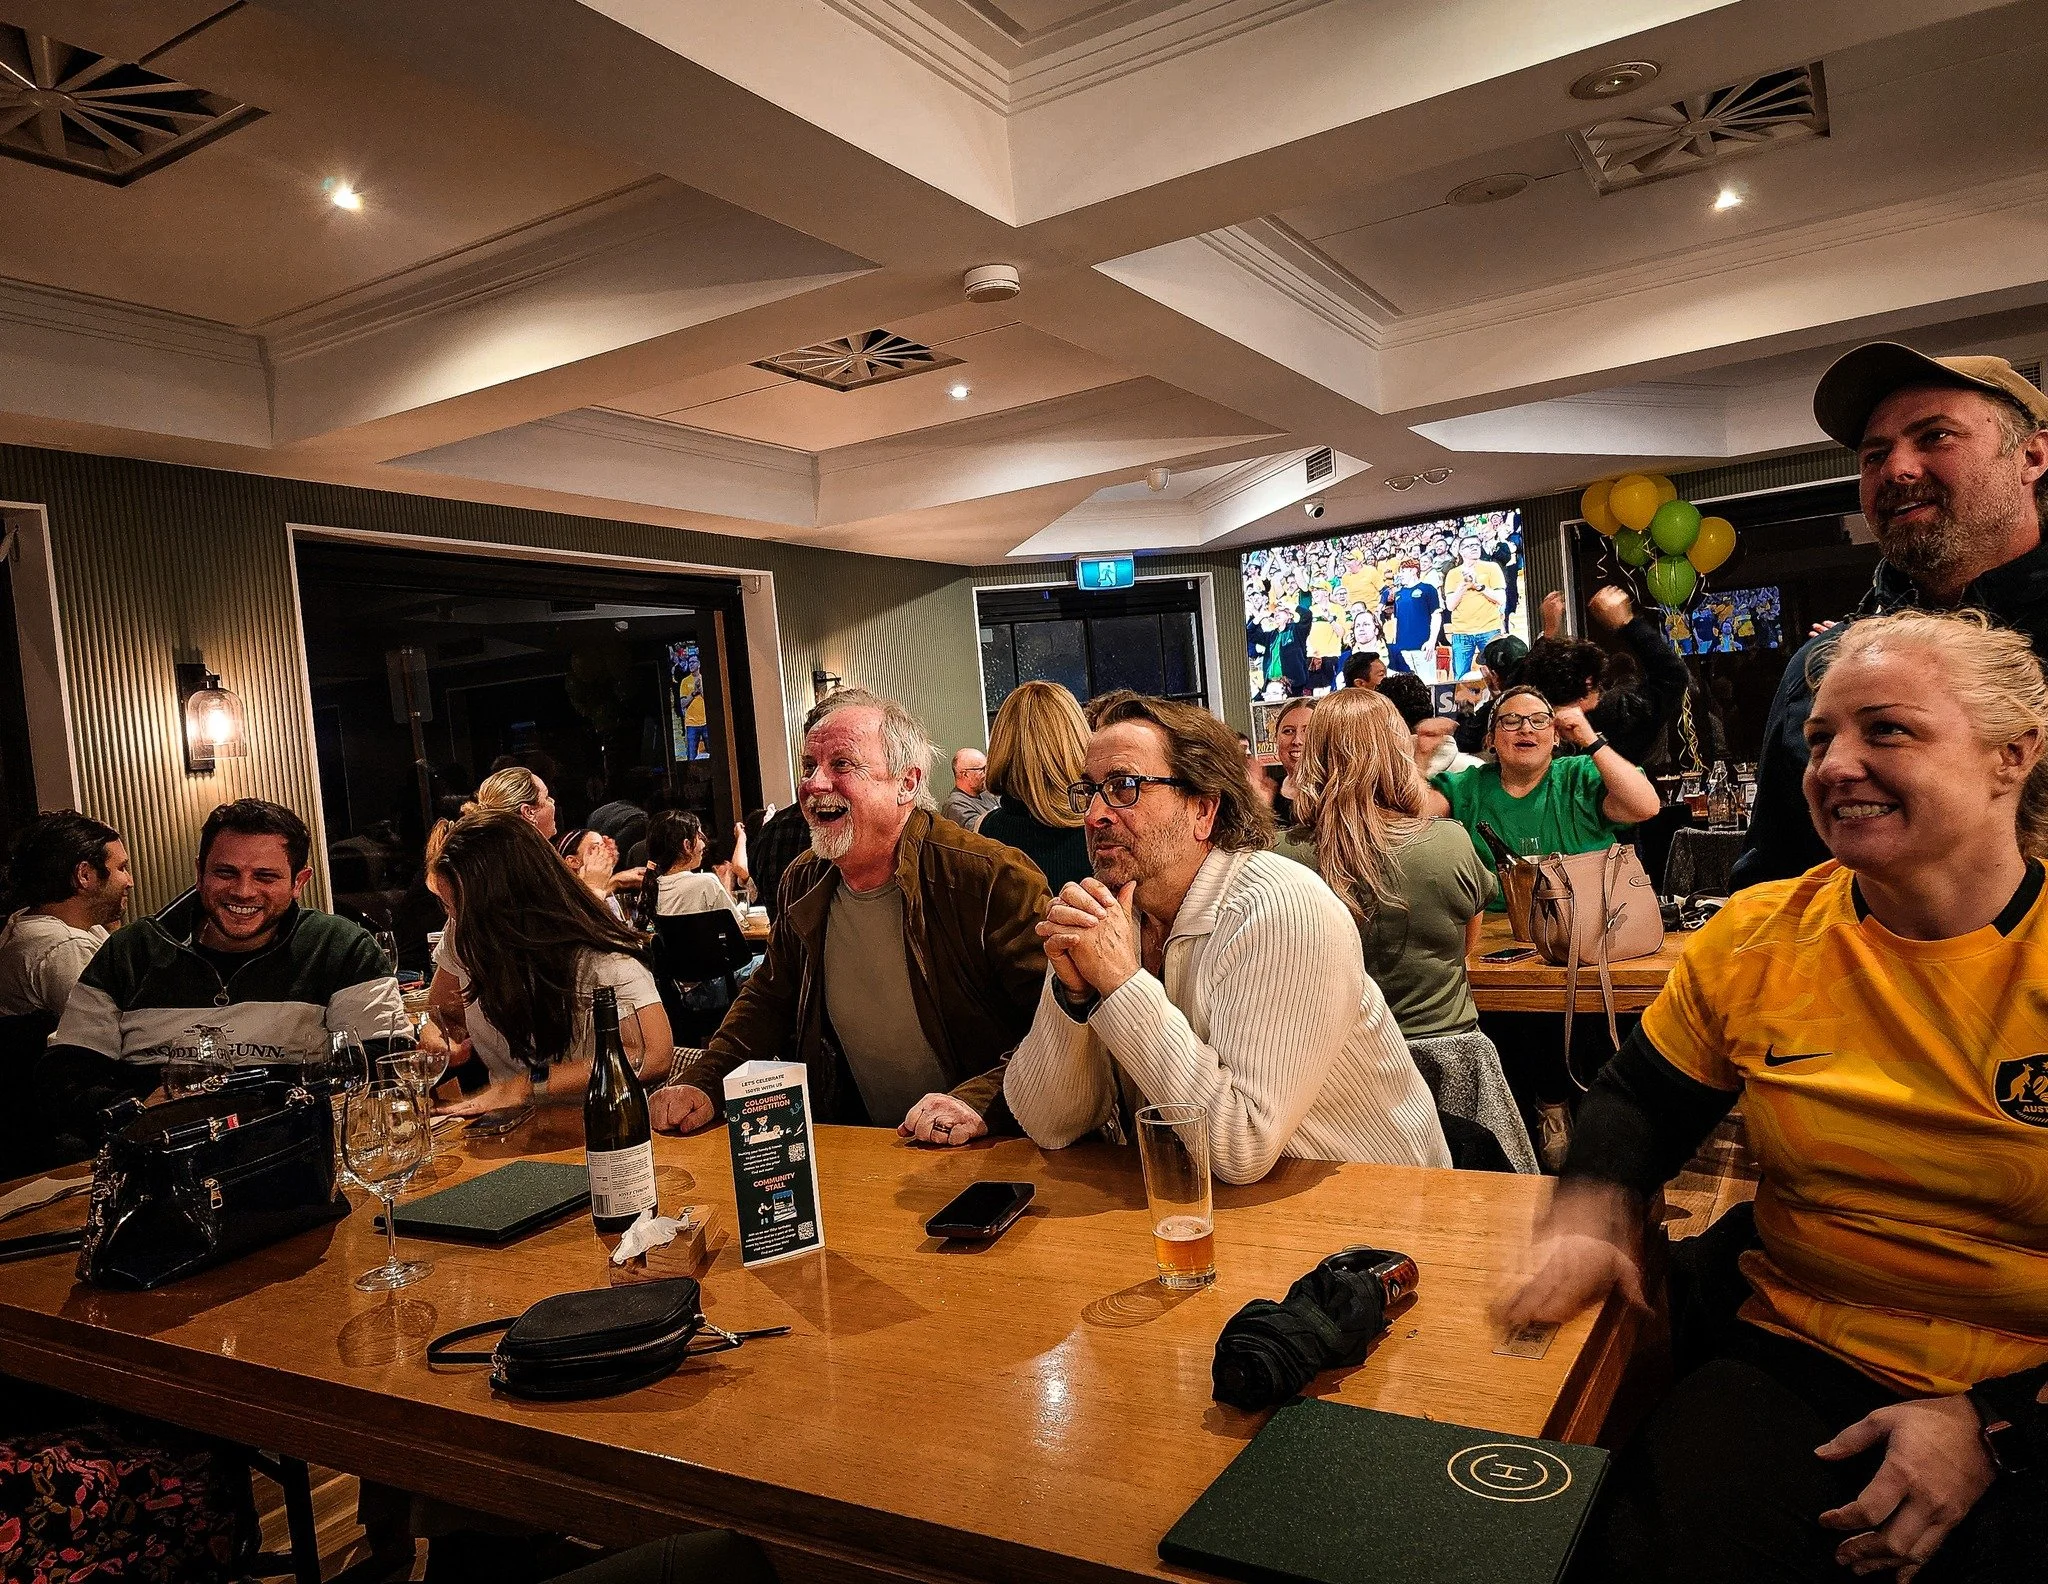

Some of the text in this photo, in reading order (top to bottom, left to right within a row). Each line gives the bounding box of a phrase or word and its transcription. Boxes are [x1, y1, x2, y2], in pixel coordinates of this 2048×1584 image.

[1257, 742, 1273, 754] 2023
[755, 1074, 784, 1084] CELEBRATE
[761, 1083, 775, 1091] WITH
[744, 1093, 787, 1107] COLOURING
[742, 1099, 790, 1115] COMPETITION
[753, 1172, 795, 1187] COMMUNITY
[765, 1182, 786, 1192] STALL
